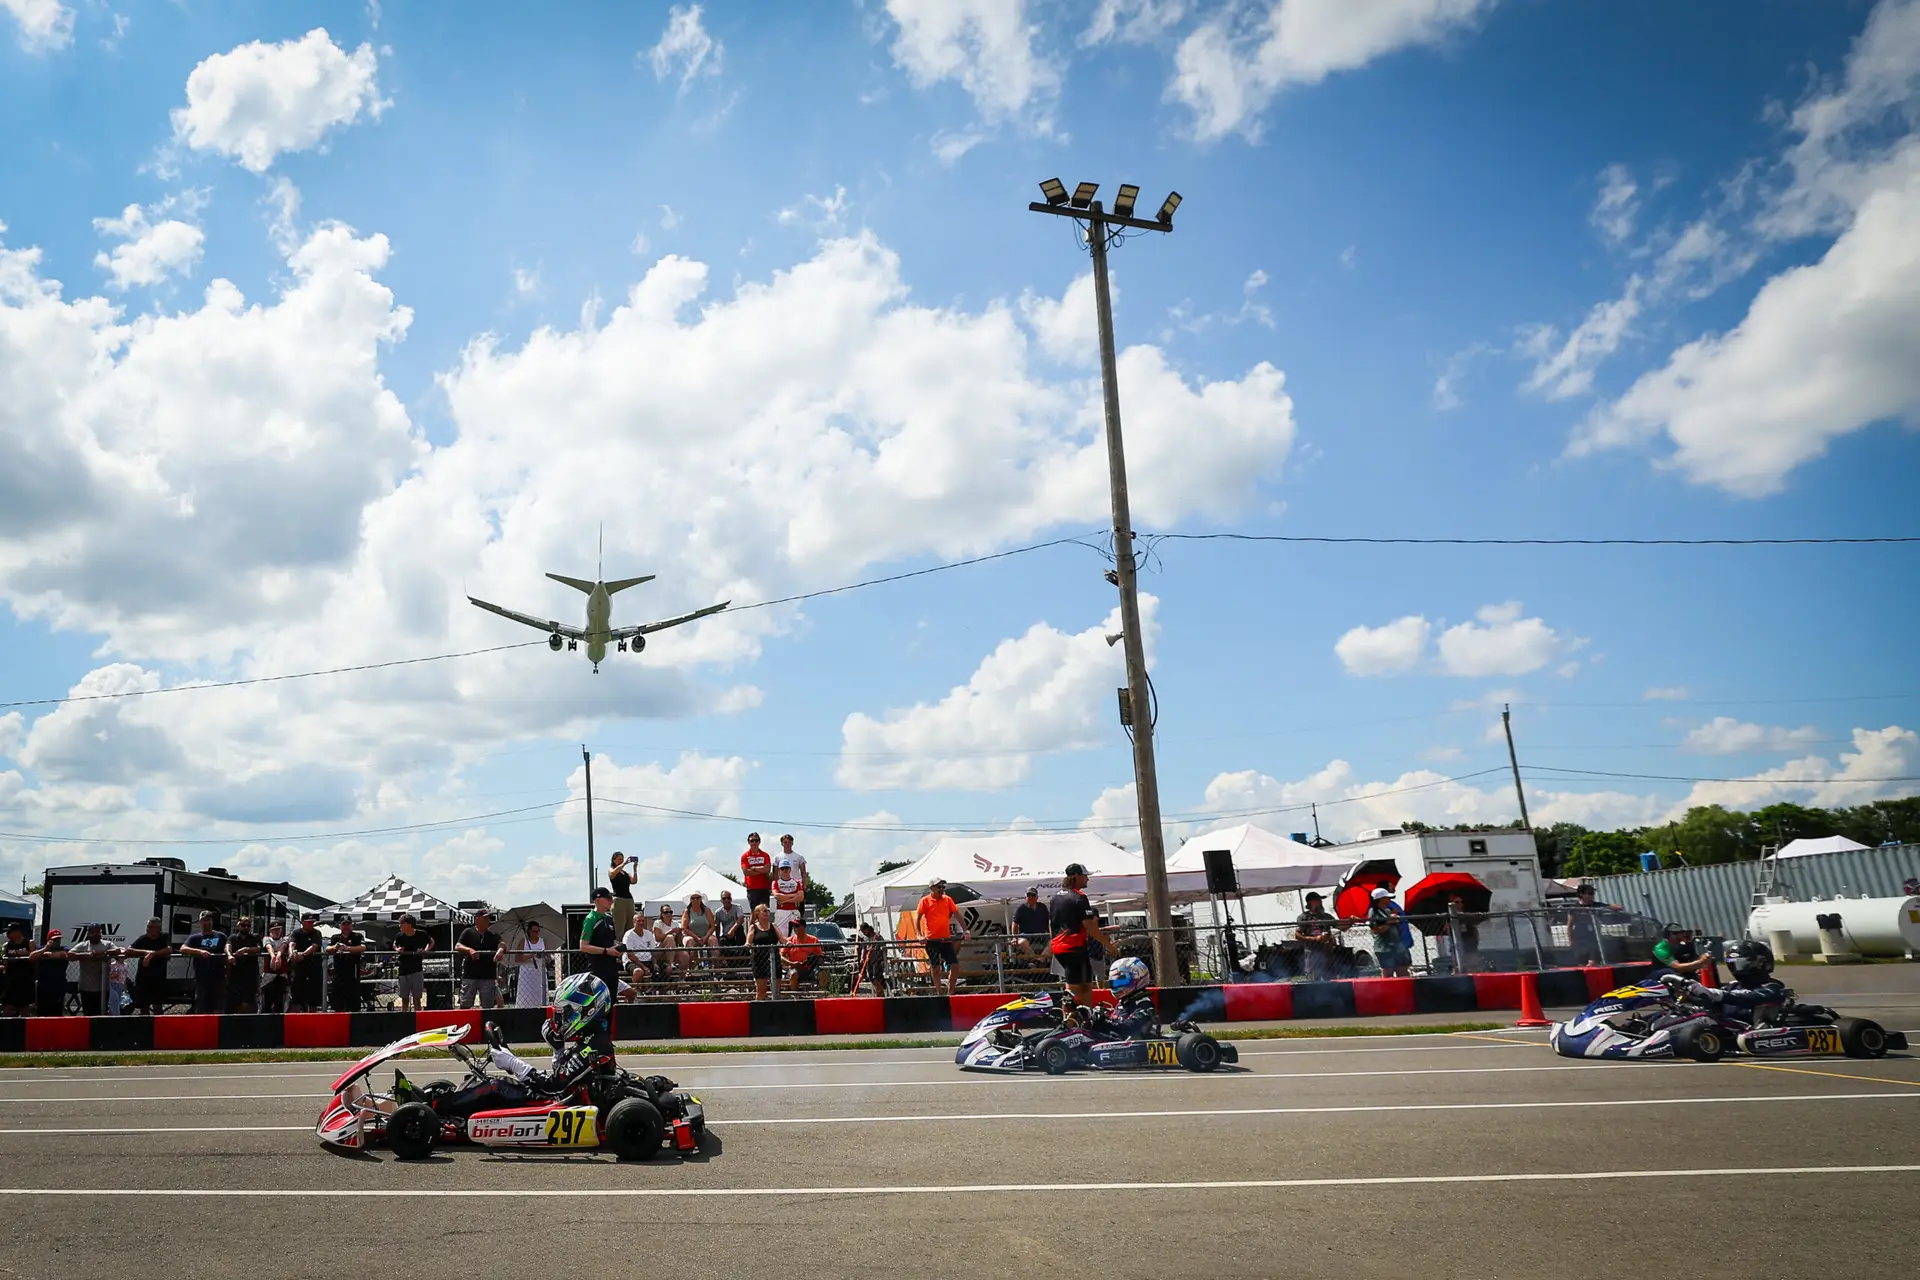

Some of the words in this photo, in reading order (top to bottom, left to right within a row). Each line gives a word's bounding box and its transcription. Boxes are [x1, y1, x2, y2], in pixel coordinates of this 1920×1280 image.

[1808, 1029, 1837, 1052] 287
[1148, 1042, 1175, 1065] 207
[471, 1123, 544, 1138] birelart
[548, 1110, 587, 1145] 297
